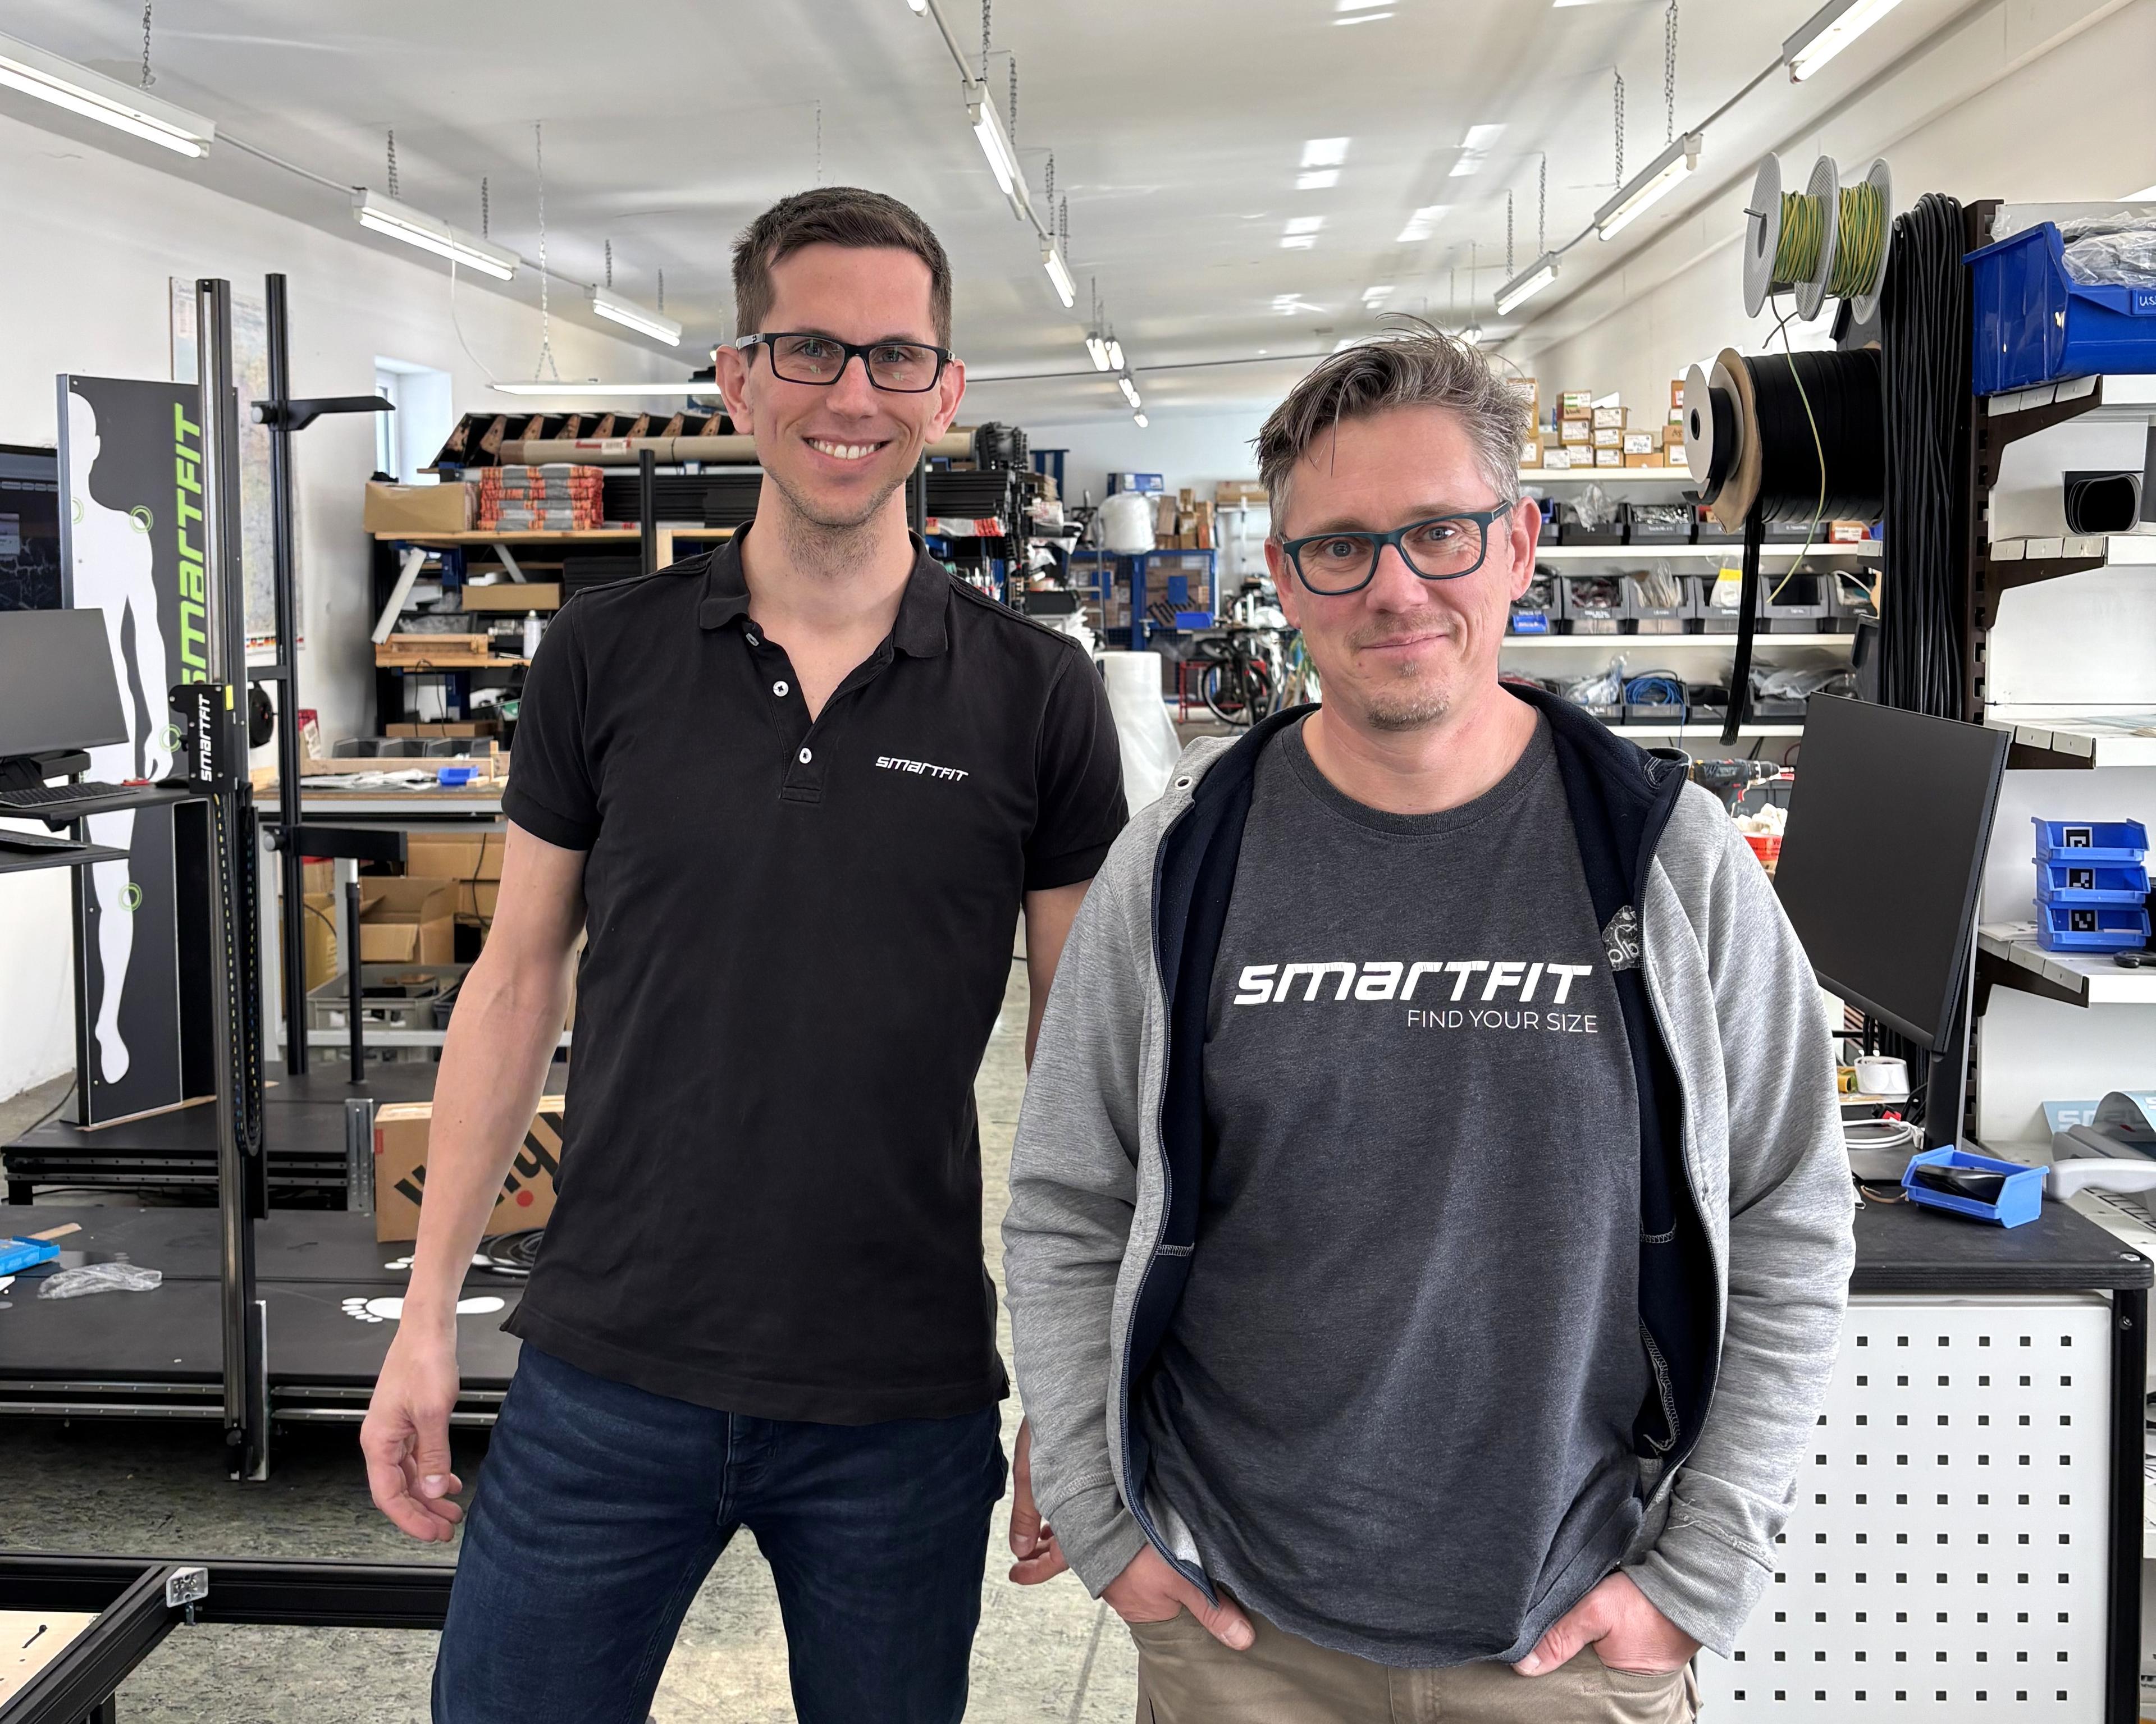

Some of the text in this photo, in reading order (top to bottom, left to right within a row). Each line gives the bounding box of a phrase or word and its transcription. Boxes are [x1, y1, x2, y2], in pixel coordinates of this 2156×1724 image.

[1408, 1009, 1598, 1033] FIND YOUR SIZE
